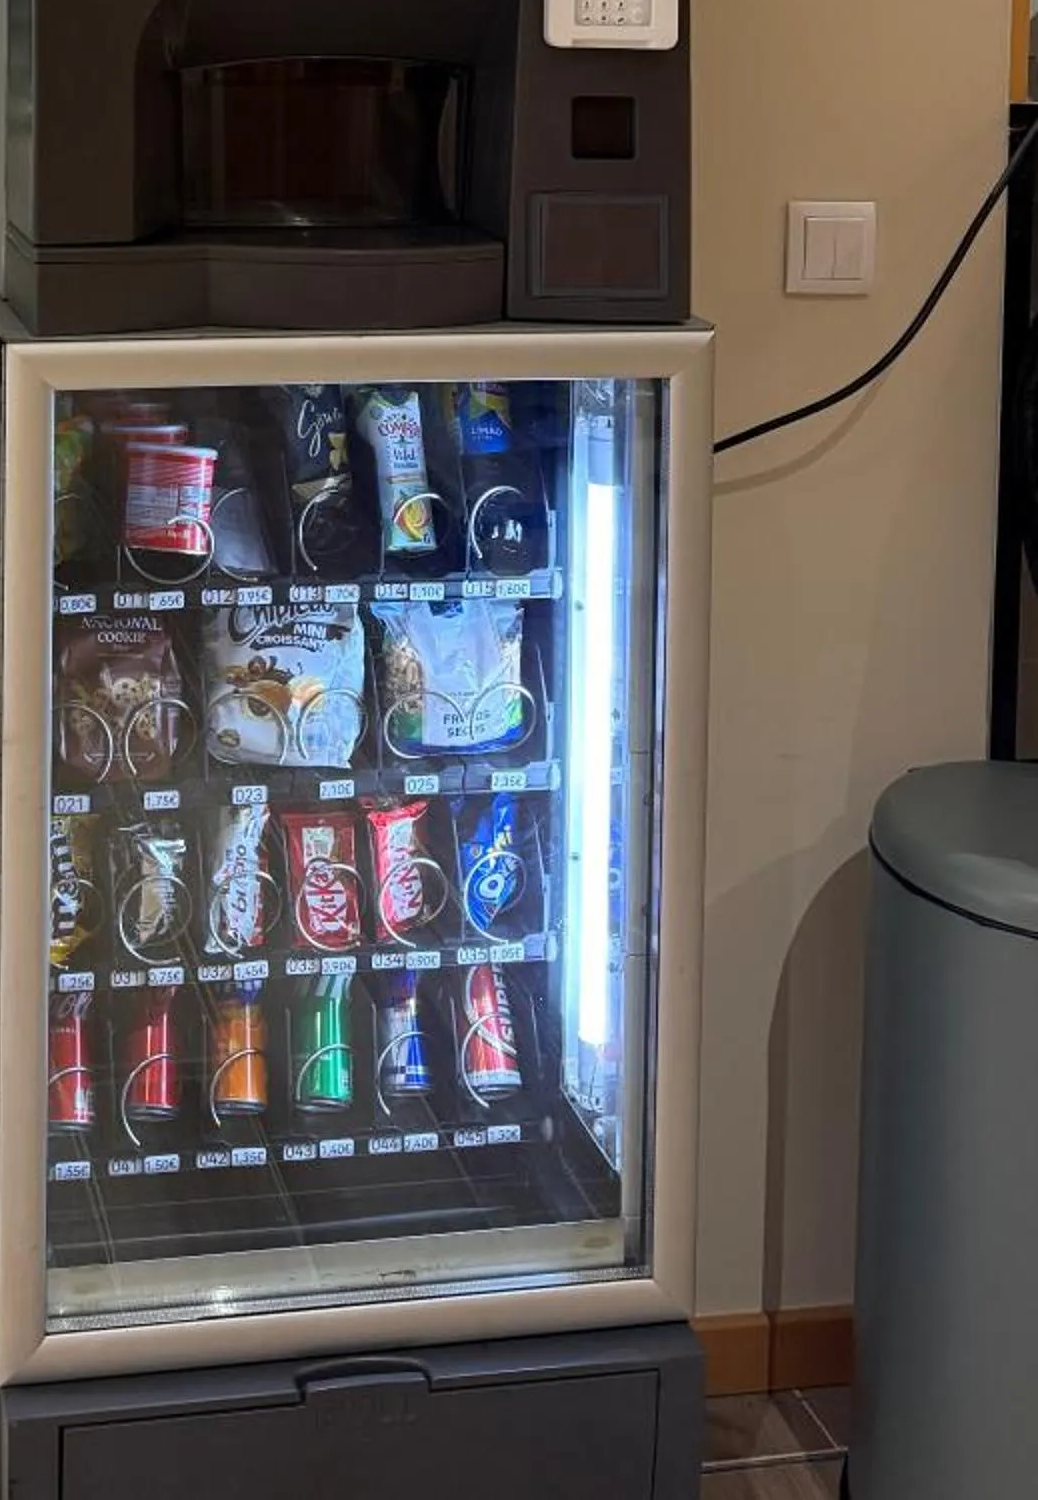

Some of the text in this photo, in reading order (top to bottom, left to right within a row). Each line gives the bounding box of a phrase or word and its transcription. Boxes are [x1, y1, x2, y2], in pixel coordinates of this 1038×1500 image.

[293, 622, 328, 639] MINI
[407, 777, 435, 792] 025
[235, 787, 264, 803] 023
[56, 797, 84, 813] 021
[199, 1151, 227, 1167] 042
